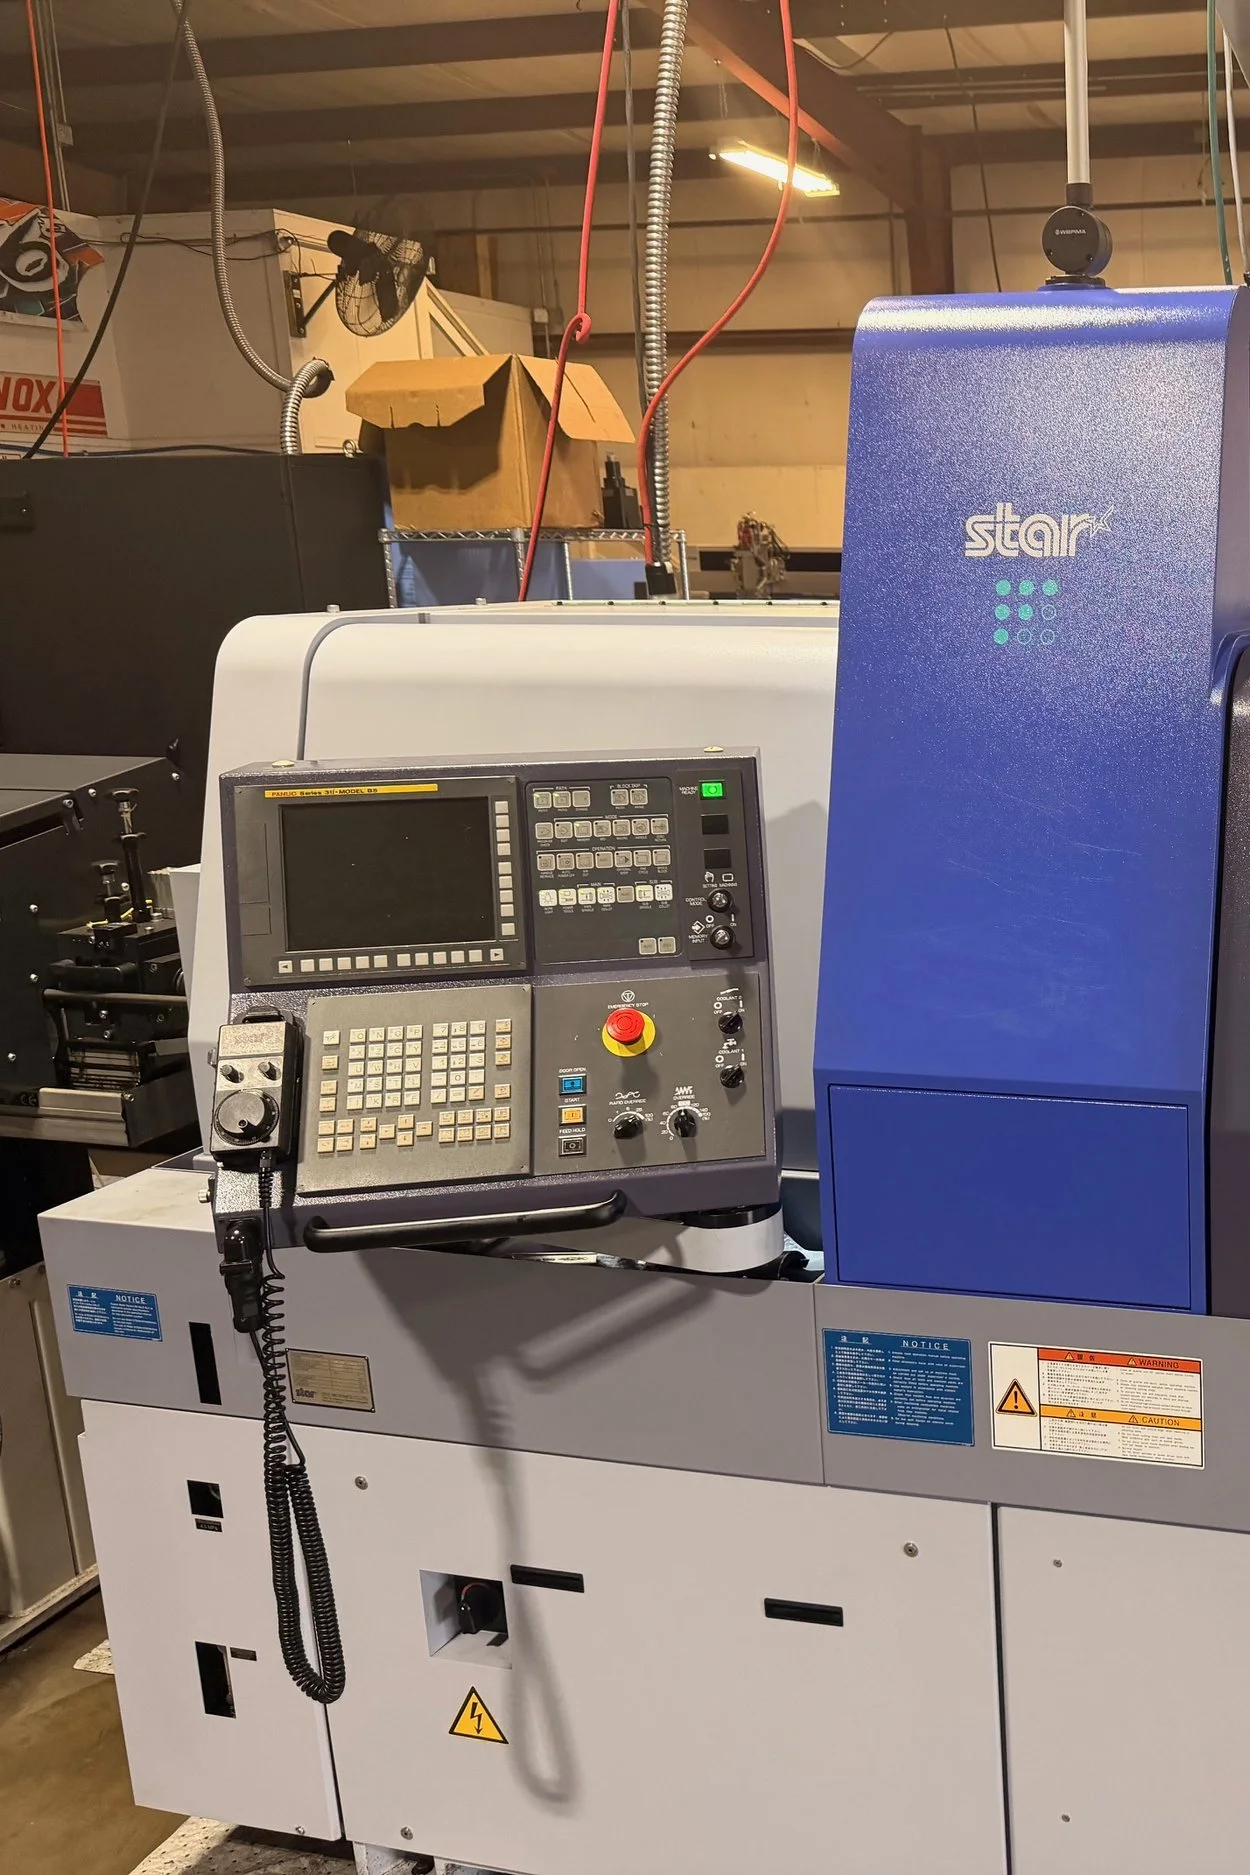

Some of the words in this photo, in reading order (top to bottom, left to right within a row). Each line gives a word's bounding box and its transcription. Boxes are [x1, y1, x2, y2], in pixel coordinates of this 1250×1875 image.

[965, 503, 1095, 557] star
[115, 1294, 146, 1304] NOTICE
[902, 1340, 950, 1350] NOTICE
[1139, 1359, 1180, 1369] WARNING
[1142, 1418, 1180, 1427] CAUTION
